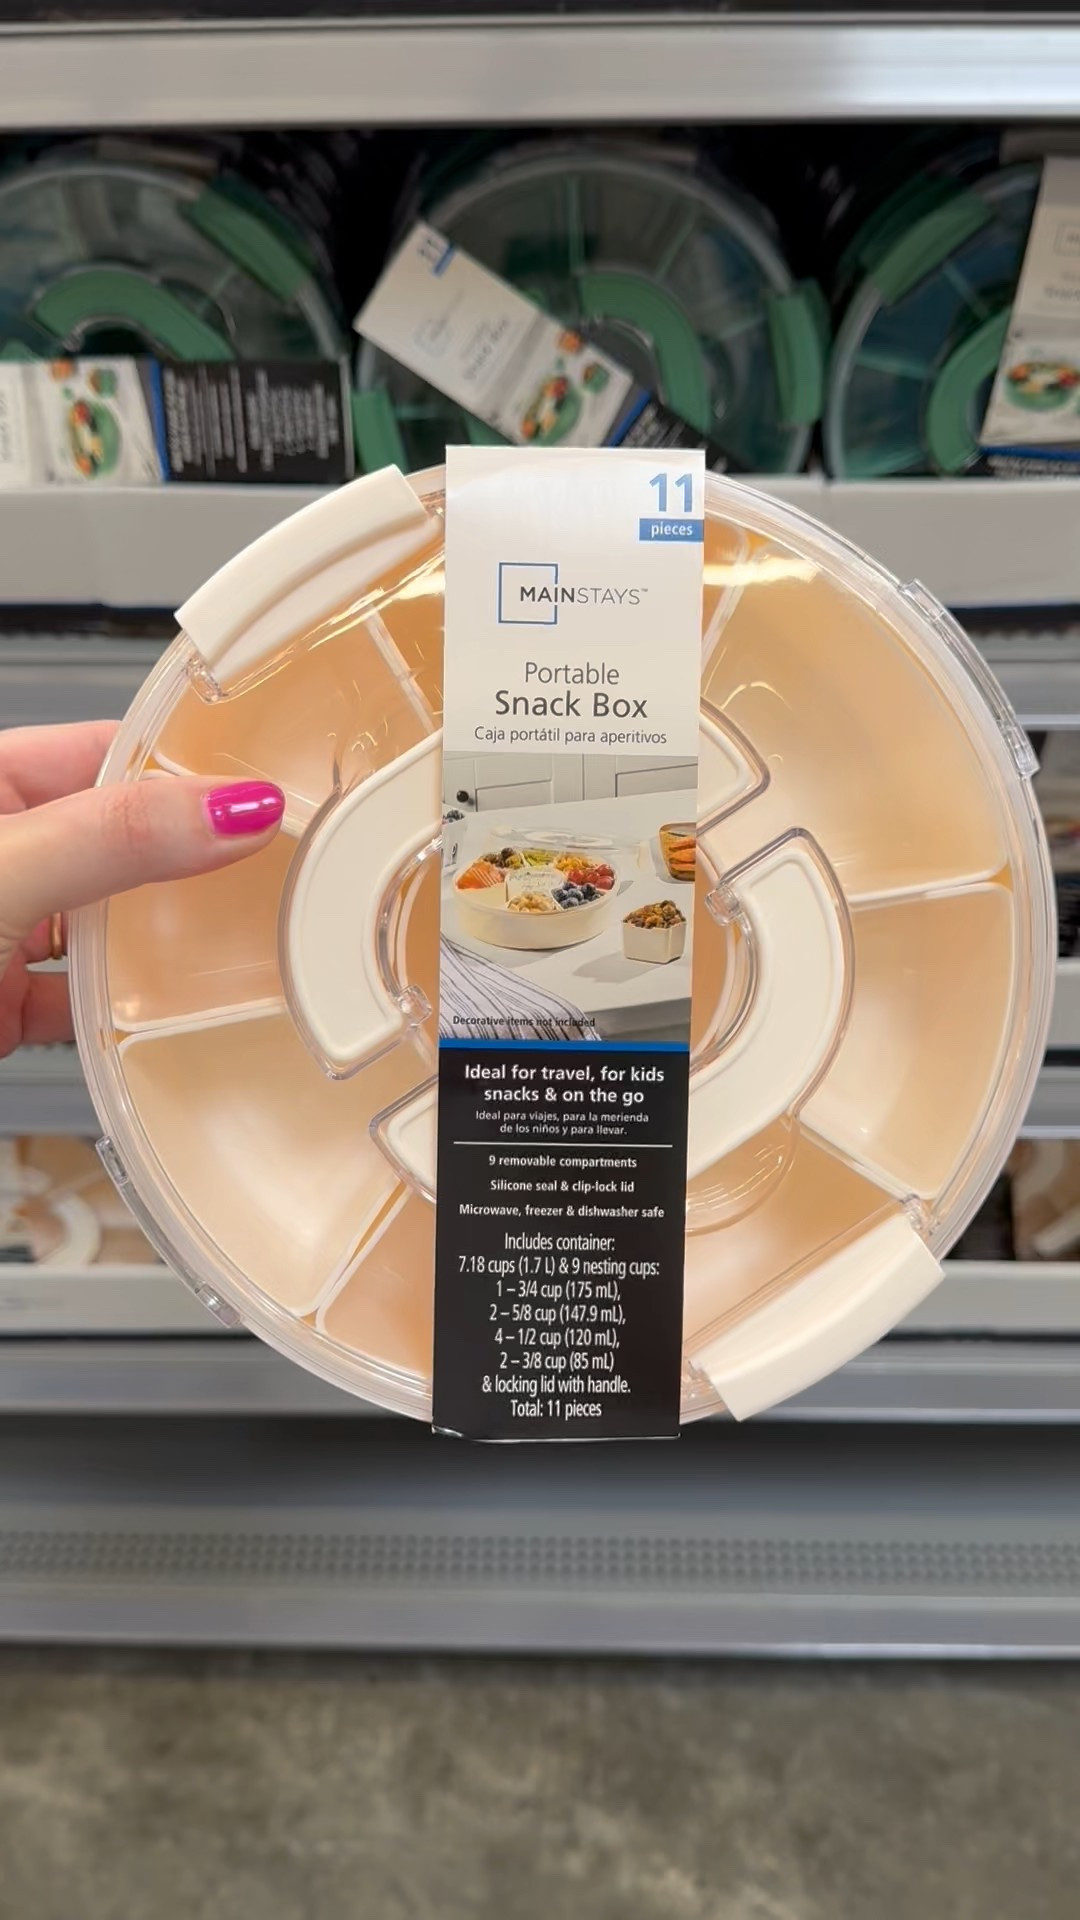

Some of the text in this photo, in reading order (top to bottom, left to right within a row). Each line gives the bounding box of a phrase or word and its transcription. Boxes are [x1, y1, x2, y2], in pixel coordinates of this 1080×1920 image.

[649, 473, 692, 512] 11
[652, 521, 692, 538] pieces
[526, 662, 619, 685] Portable
[496, 690, 647, 718] Snack Box
[475, 726, 667, 745] Caja portátil para aperitivos
[453, 1014, 595, 1029] Decorative items not included
[466, 1064, 664, 1082] Ideal for travel, for kids
[485, 1086, 644, 1106] snacks & on the go
[476, 1111, 648, 1122] Ideal para viajes, para la merienda
[500, 1123, 626, 1135] de los niños y para llevar.
[489, 1155, 636, 1169] 9 removable compartments
[491, 1180, 634, 1194] Silicone seal & clip-lock lid
[460, 1204, 664, 1217] Microwave, freezer & dishwasher safe
[505, 1232, 614, 1250] Includes container:
[459, 1256, 659, 1279] 7.18 cups (1.7 L) & 9 nesting cups:
[497, 1280, 501, 1296] 1
[519, 1280, 537, 1297] 3/4
[541, 1285, 562, 1302] cup
[566, 1280, 592, 1300] (175
[596, 1281, 620, 1301] mL),
[490, 1304, 497, 1320] 2
[513, 1304, 531, 1320] 5/8
[535, 1308, 556, 1325] cup
[560, 1304, 597, 1324] (147.9
[601, 1305, 625, 1324] mL),
[495, 1328, 502, 1344] 4
[518, 1328, 536, 1345] 1/2
[540, 1332, 561, 1349] cup
[565, 1328, 591, 1347] (120
[595, 1328, 619, 1348] mL),
[500, 1352, 507, 1368] 2
[523, 1352, 541, 1368] 3/8
[545, 1356, 566, 1373] cup
[570, 1352, 588, 1371] (85
[592, 1352, 614, 1372] mL)
[482, 1375, 630, 1397] & locking lid with handle.
[511, 1399, 601, 1420] Total: 11 pieces
